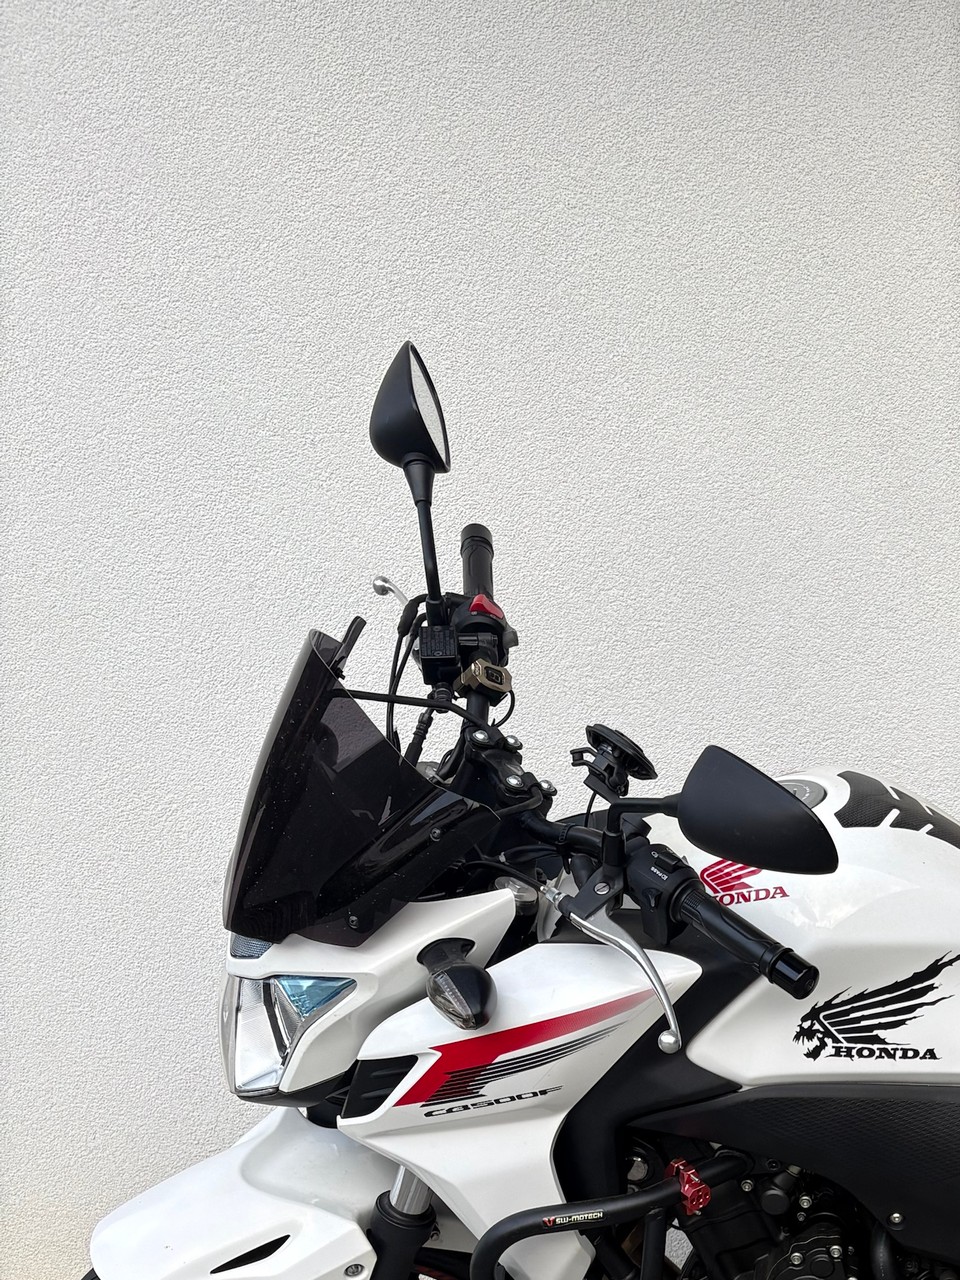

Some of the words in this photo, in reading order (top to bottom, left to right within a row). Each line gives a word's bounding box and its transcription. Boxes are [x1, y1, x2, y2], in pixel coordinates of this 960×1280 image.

[713, 886, 790, 907] ONDA
[831, 1046, 942, 1061] HONDA
[424, 1085, 563, 1118] CB500F
[555, 1211, 603, 1225] SW-MOTECH
